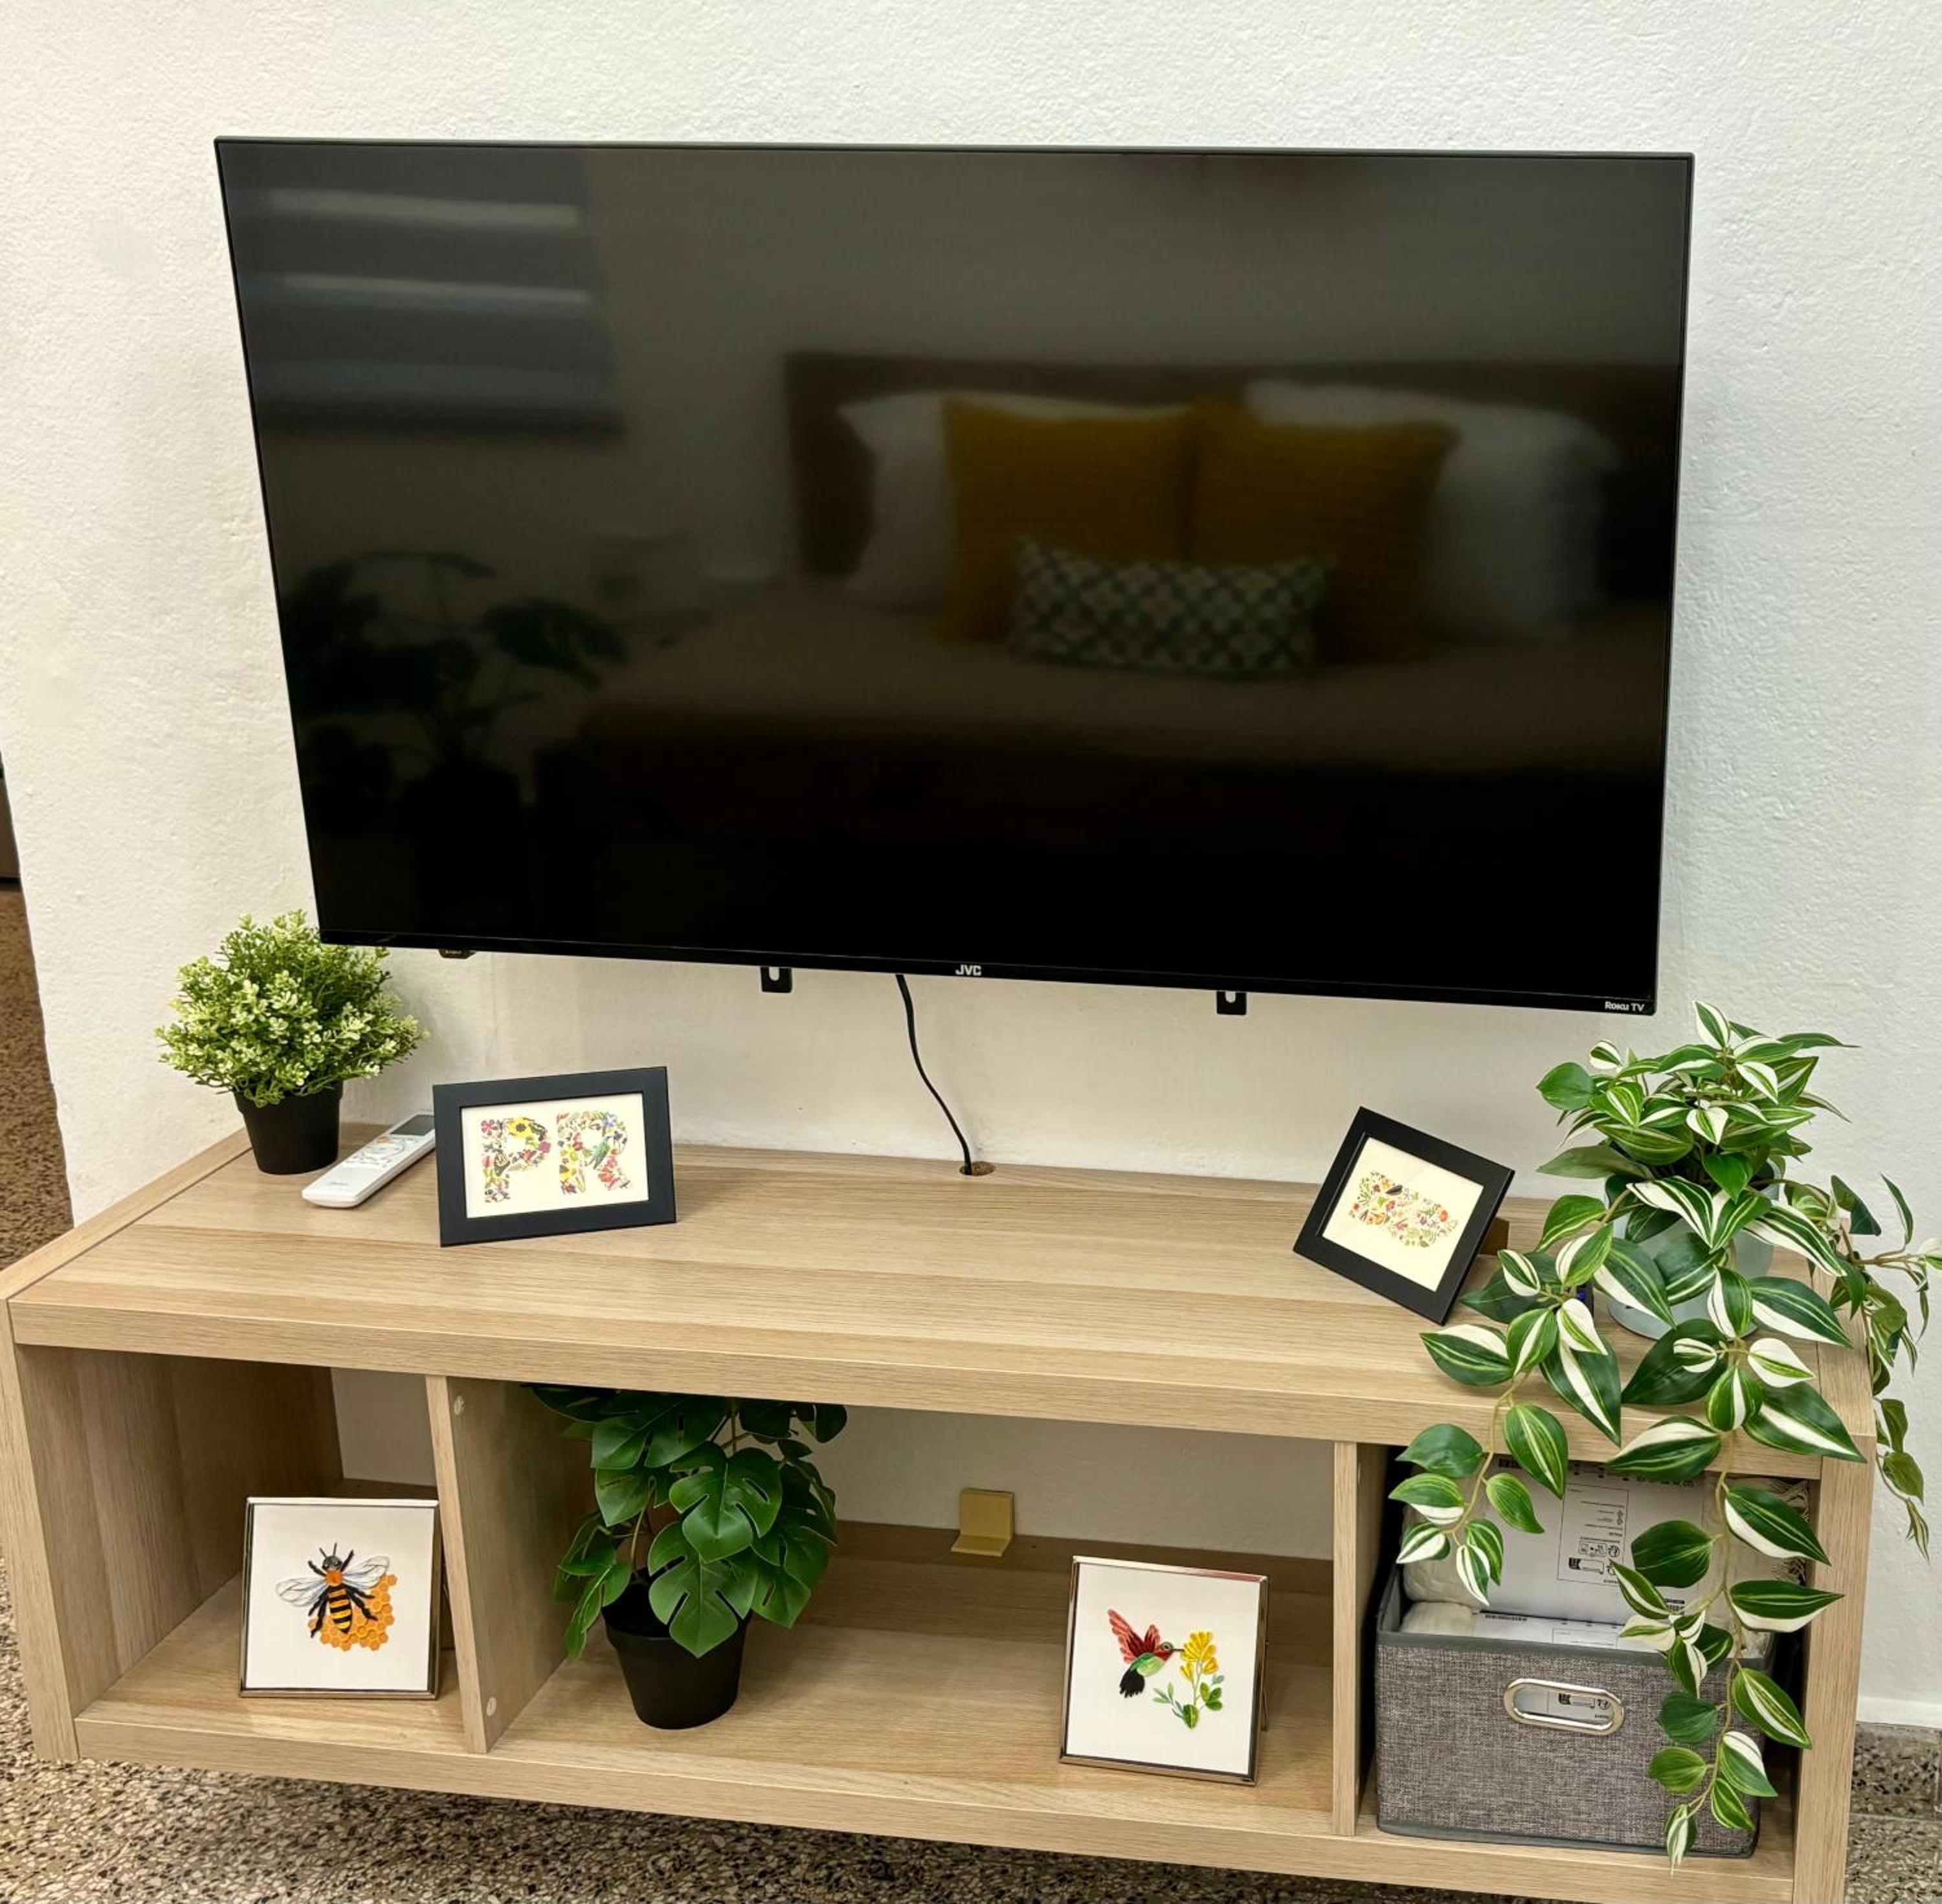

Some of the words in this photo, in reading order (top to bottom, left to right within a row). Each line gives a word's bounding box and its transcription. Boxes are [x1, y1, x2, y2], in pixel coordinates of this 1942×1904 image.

[955, 964, 981, 976] JVC
[1605, 1001, 1629, 1011] Roku
[1631, 1003, 1645, 1012] TV
